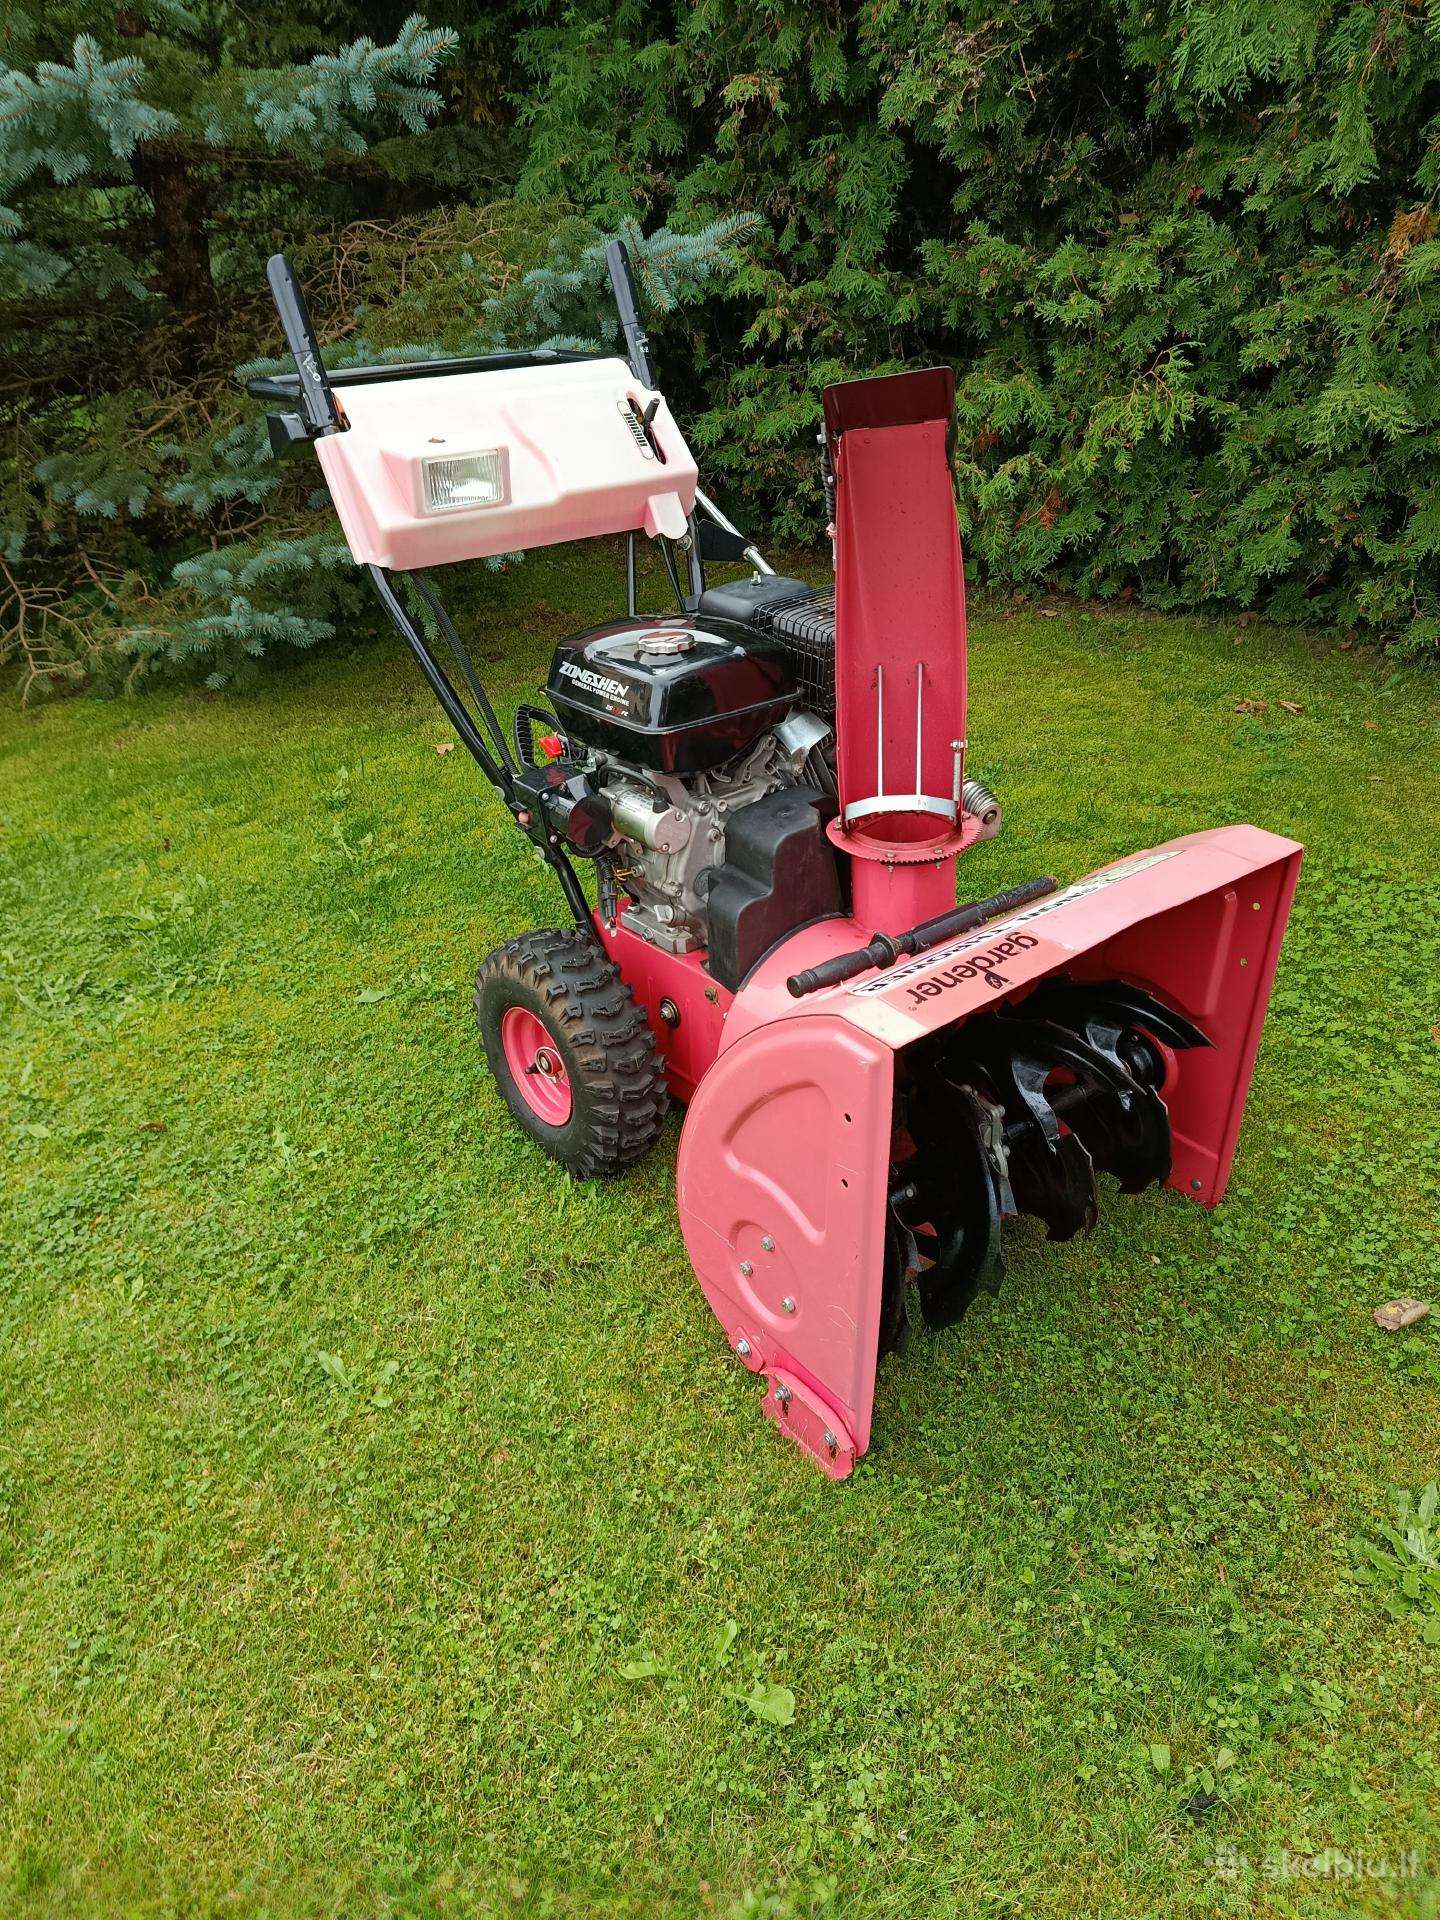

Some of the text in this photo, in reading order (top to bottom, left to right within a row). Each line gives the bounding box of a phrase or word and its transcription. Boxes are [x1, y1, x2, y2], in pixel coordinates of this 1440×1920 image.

[559, 661, 630, 698] ZONGSHEN
[571, 678, 630, 707] GENERAL POWER ENGINE
[906, 931, 1039, 1005] gardener
